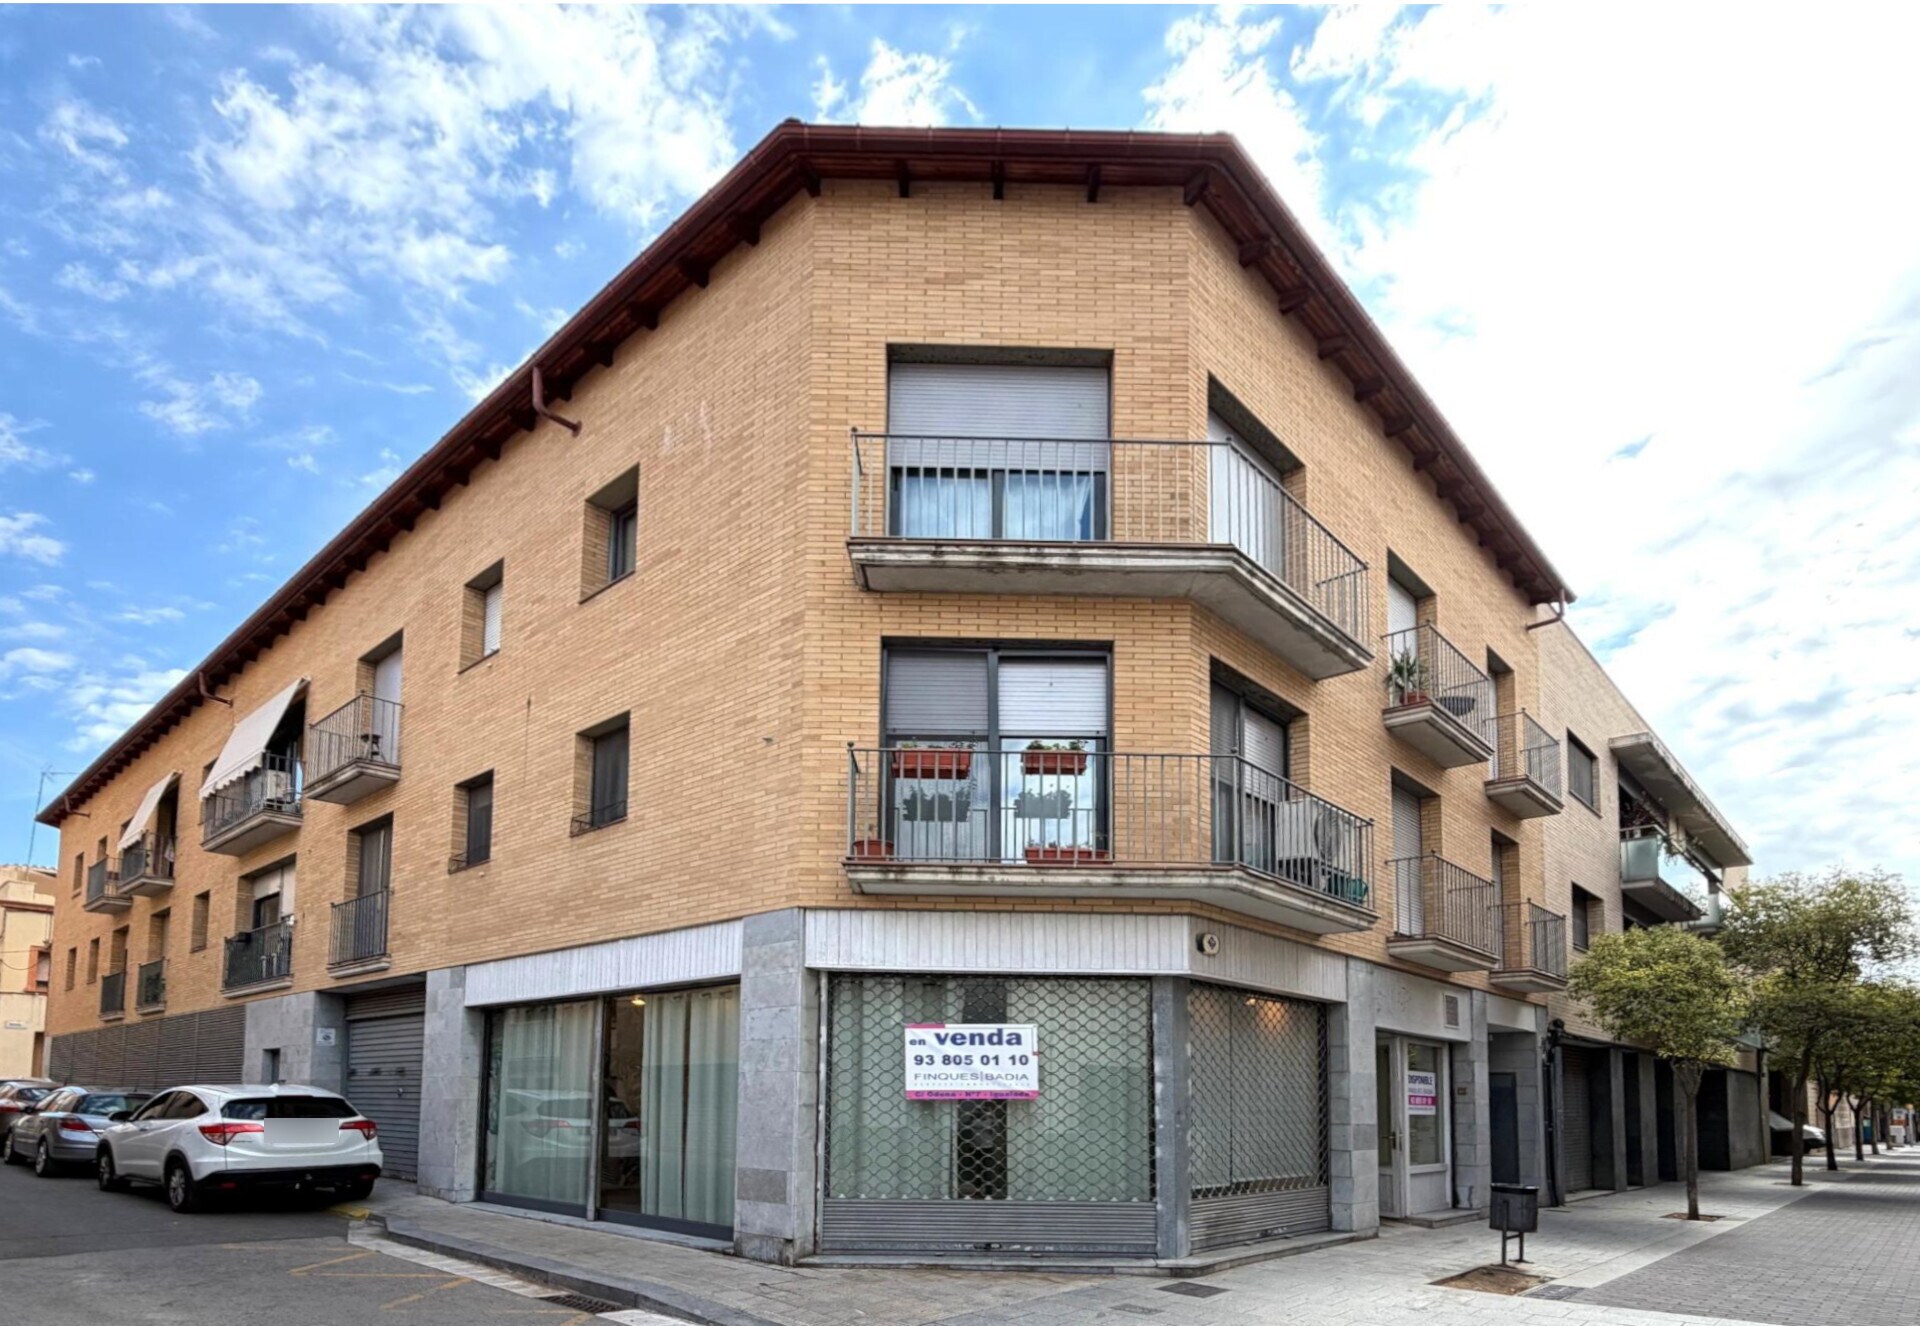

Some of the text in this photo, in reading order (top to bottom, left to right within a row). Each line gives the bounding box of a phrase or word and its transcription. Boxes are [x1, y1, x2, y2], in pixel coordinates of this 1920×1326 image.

[909, 1028, 1023, 1046] en venda
[914, 1055, 1029, 1066] 93 805 01 10
[914, 1072, 1029, 1081] FINQUES BADIA
